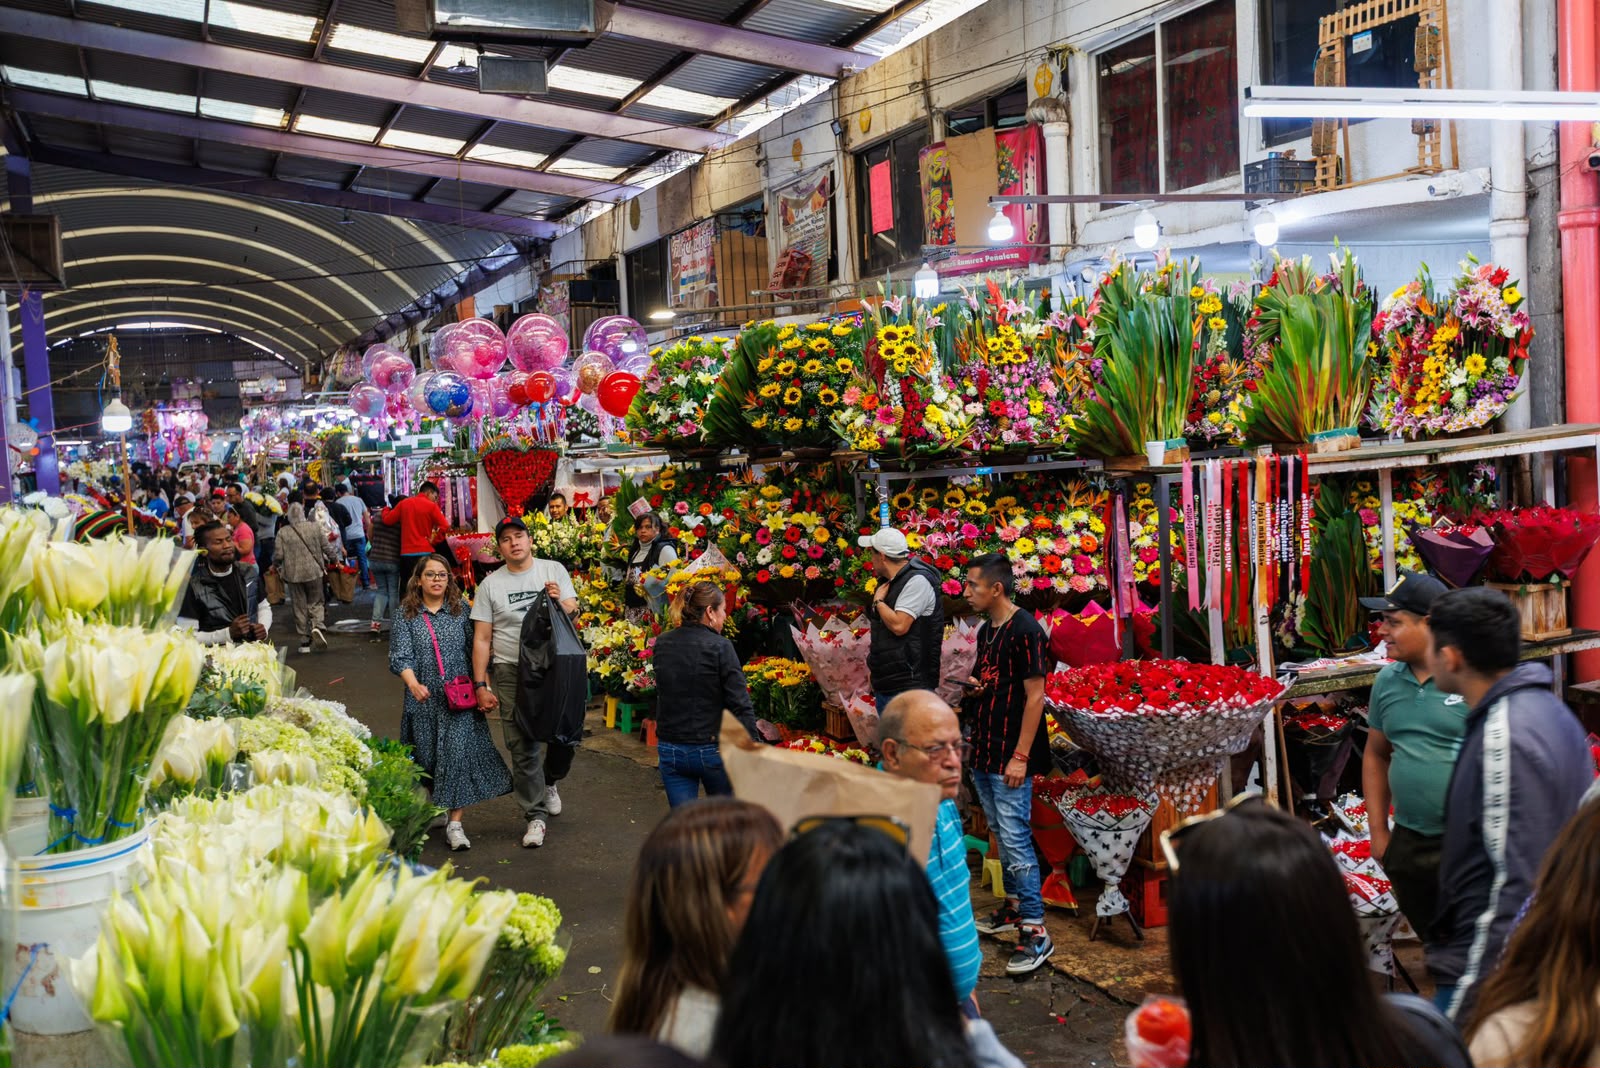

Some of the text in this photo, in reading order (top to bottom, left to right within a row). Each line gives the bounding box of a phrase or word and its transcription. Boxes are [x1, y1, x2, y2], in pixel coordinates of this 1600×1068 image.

[985, 253, 1020, 262] Peñaloza
[1258, 502, 1266, 517] Para
[1212, 504, 1222, 567] ¡Felicidades!
[1258, 525, 1266, 538] más
[1301, 499, 1311, 556] Para mi Princesa
[1187, 529, 1195, 549] persona
[1280, 519, 1289, 557] Cumpleaños
[1258, 539, 1266, 562] Bonita
[1188, 556, 1196, 568] Eres
